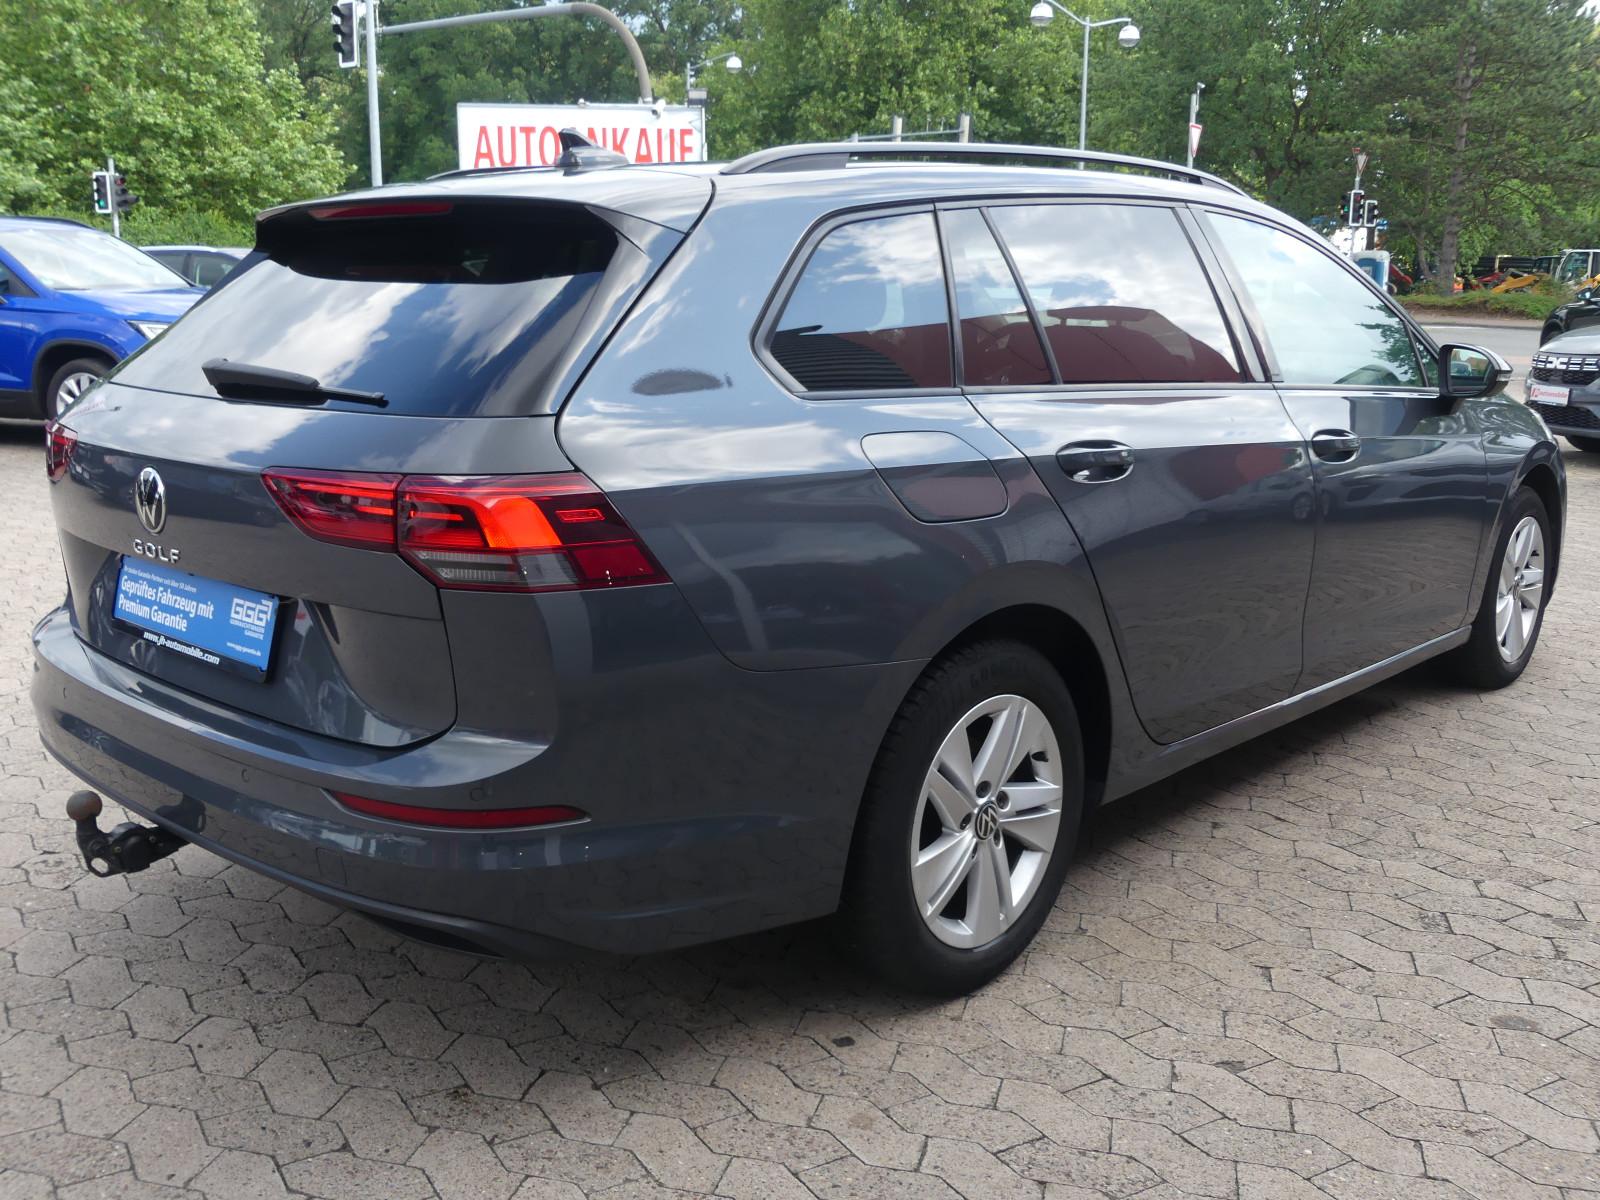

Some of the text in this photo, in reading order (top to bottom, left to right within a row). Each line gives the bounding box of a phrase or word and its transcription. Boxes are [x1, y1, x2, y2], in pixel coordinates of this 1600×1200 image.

[474, 125, 694, 168] AUTONKAUF
[133, 538, 180, 563] GOLF
[118, 594, 187, 632] Premium Garantie
[121, 575, 214, 620] Geprüftes Fahrzeug mit
[230, 597, 269, 627] GGG
